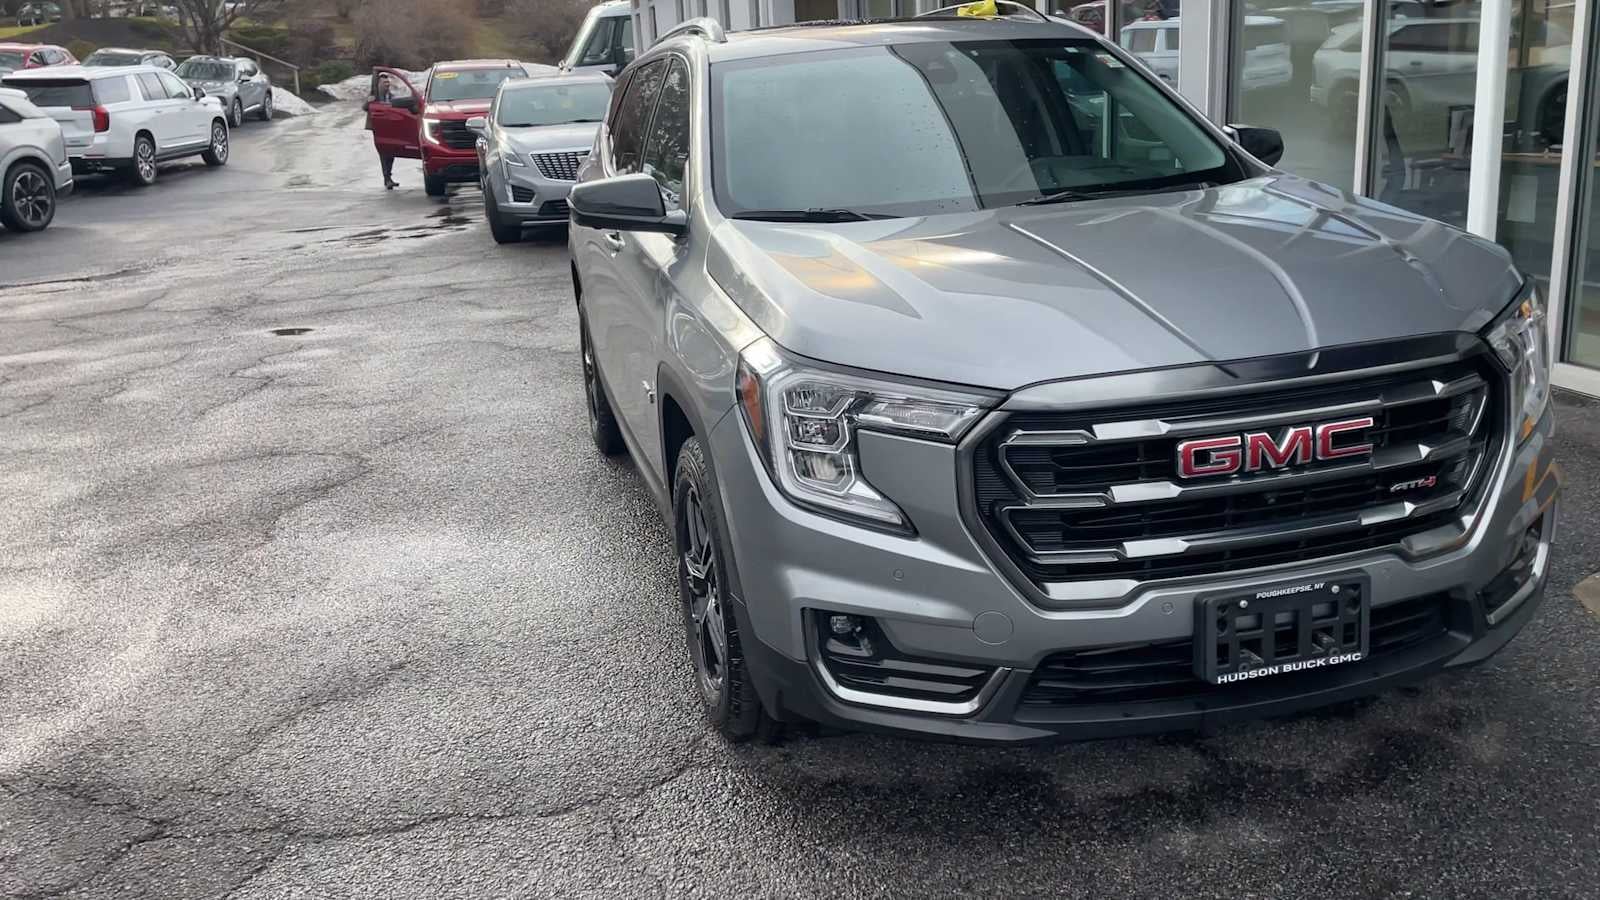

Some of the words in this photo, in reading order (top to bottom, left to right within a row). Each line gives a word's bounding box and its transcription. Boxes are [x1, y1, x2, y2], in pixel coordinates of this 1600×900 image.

[1177, 417, 1374, 478] GMC
[1217, 667, 1279, 684] HUDSON
[1282, 657, 1326, 673] BUICK
[1329, 653, 1362, 666] GMC
